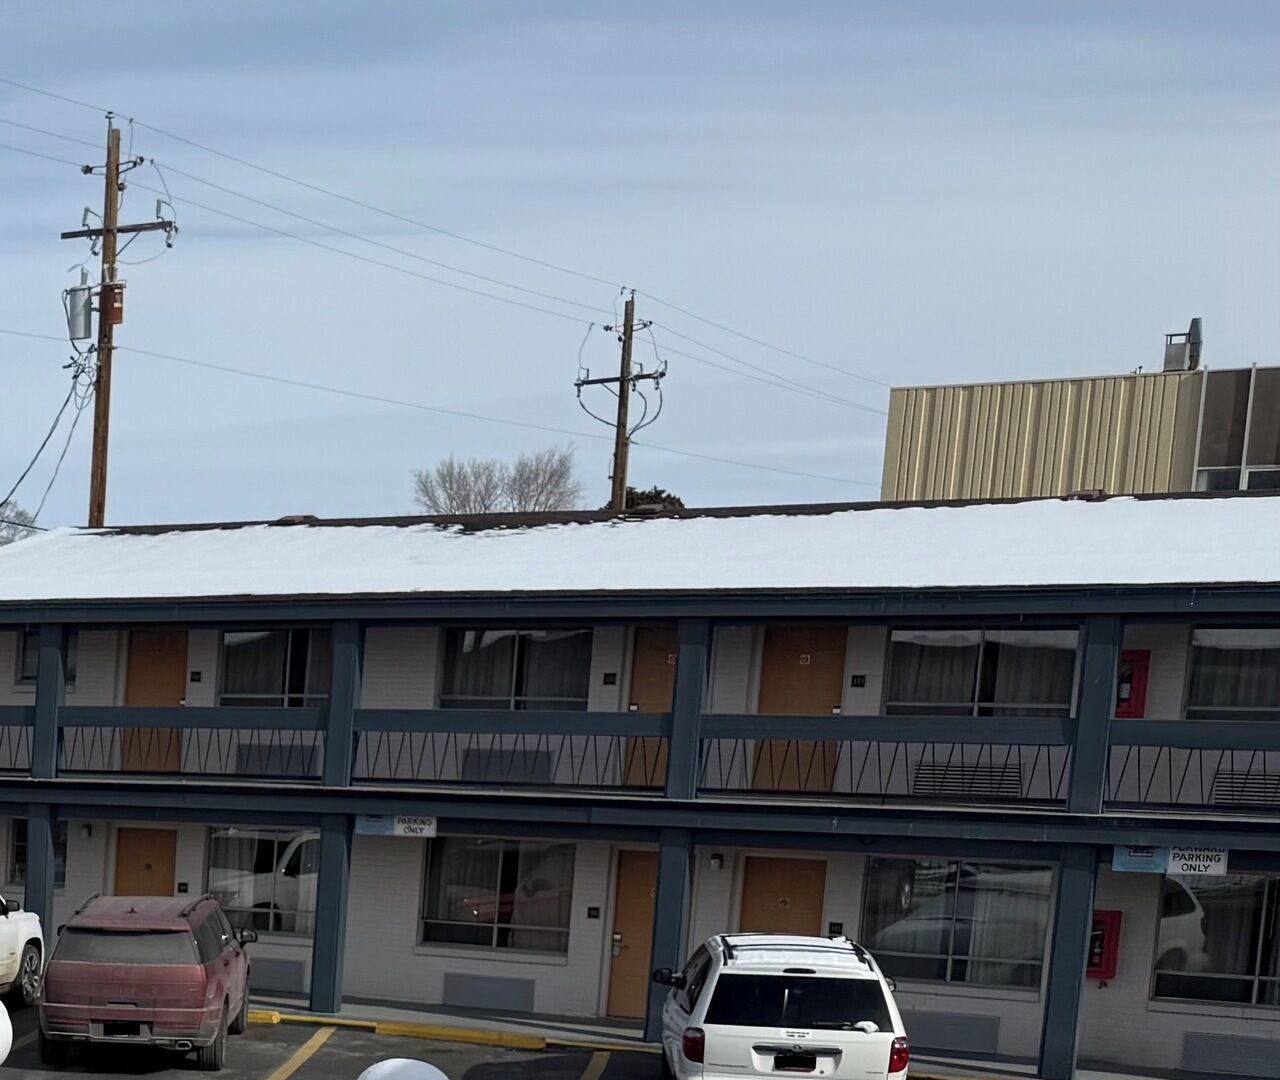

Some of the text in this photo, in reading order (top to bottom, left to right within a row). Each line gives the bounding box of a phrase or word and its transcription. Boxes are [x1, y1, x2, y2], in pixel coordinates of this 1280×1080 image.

[397, 816, 433, 826] PARKING
[403, 825, 425, 834] ONLY
[1172, 852, 1222, 863] PARKING
[1181, 863, 1211, 873] ONLY
